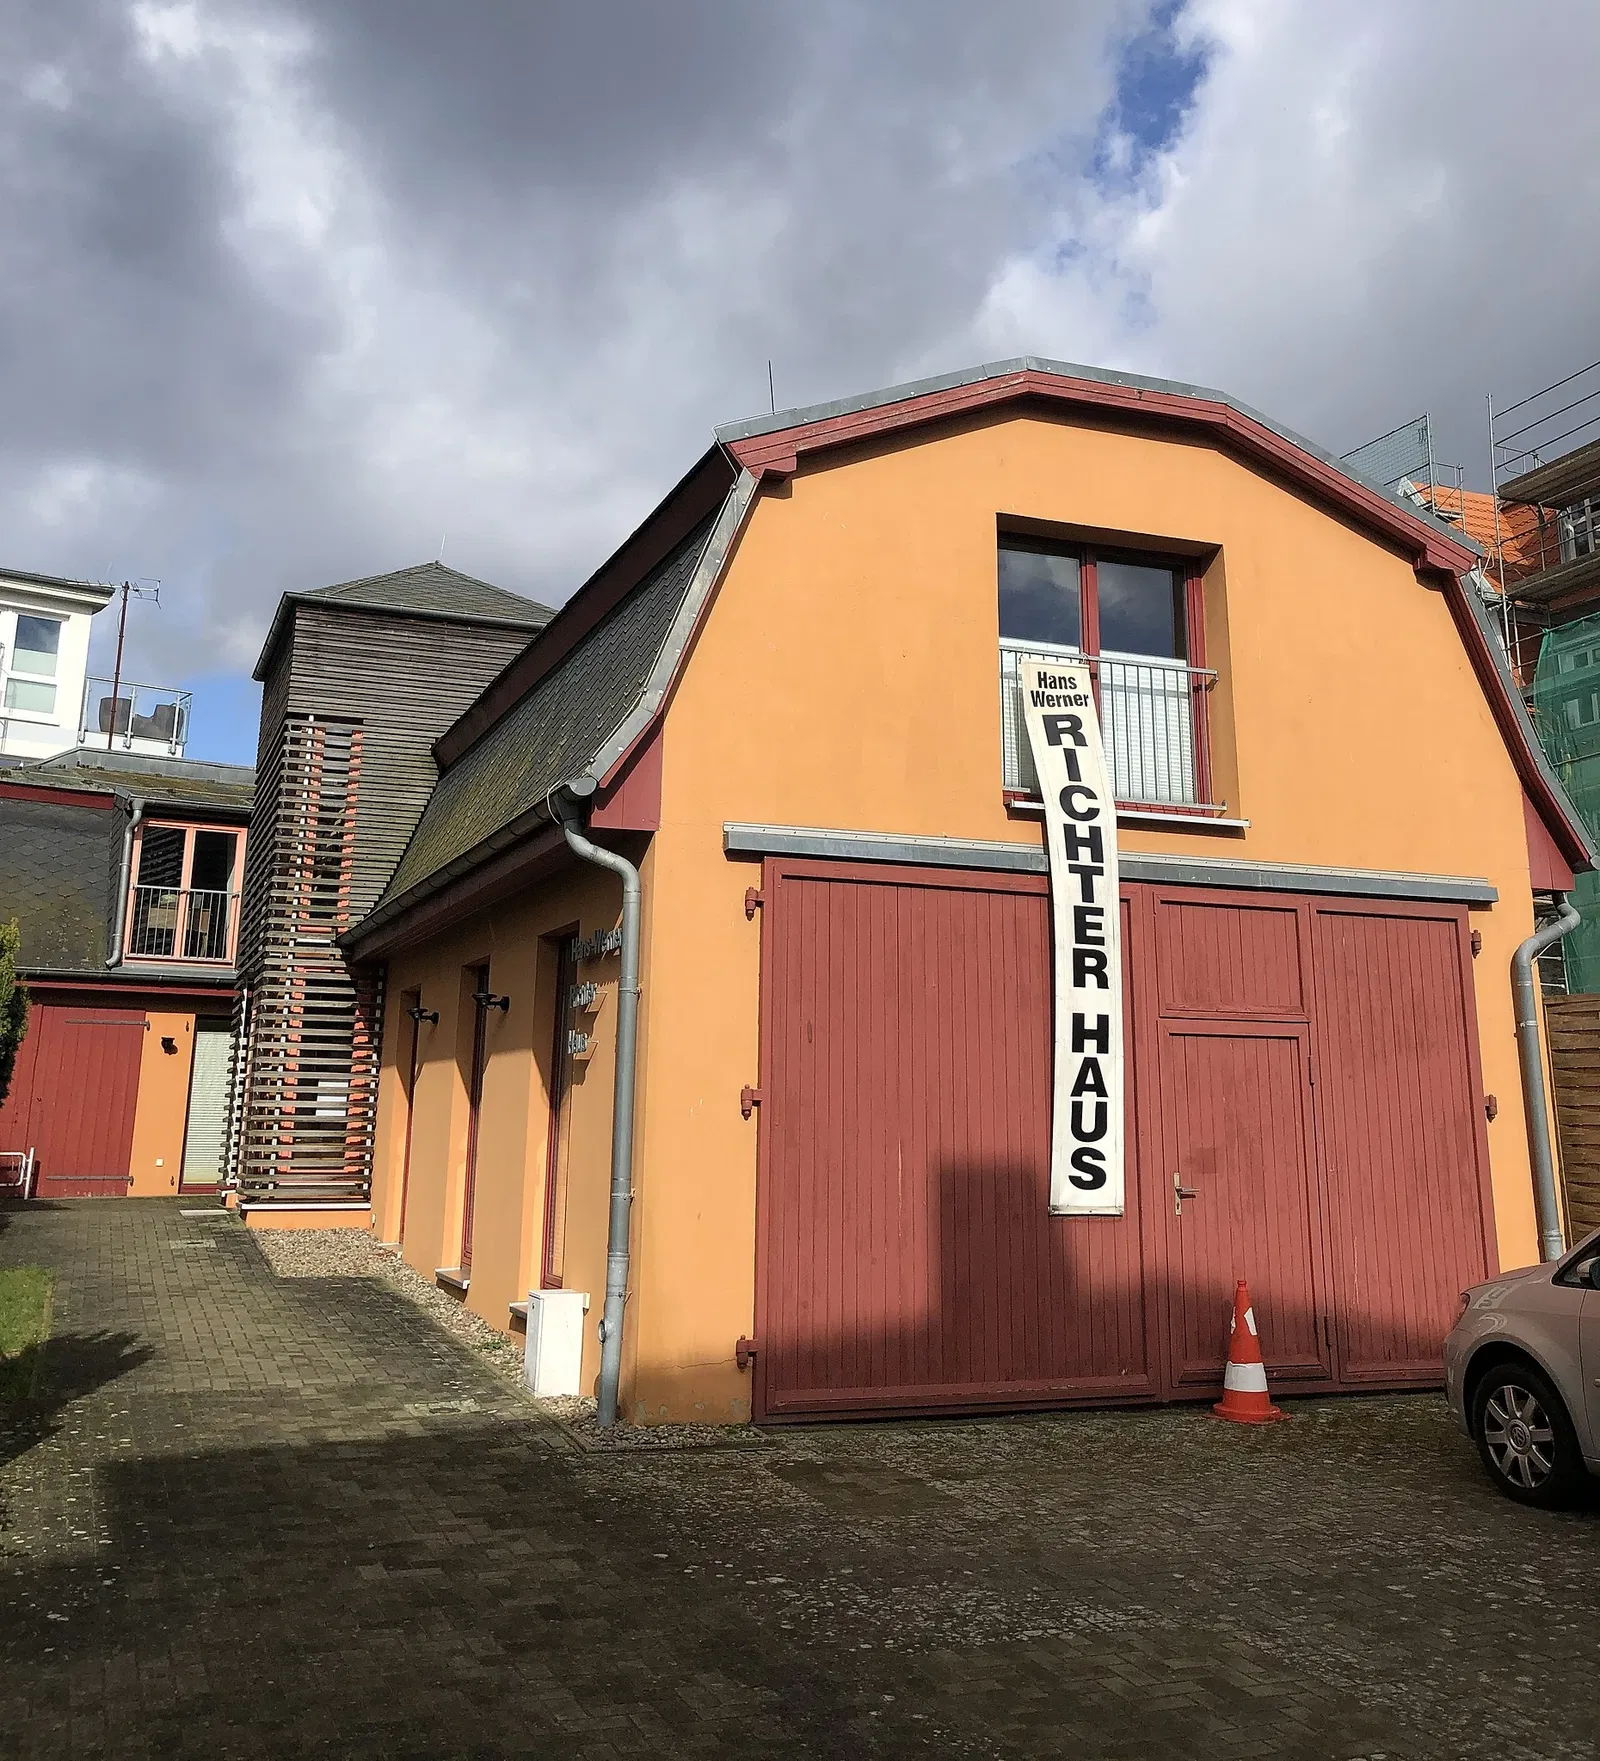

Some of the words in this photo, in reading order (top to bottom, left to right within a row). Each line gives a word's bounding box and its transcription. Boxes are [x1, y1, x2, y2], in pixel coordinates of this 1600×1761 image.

[1030, 690, 1090, 709] Werner
[1037, 671, 1078, 690] Hans
[1042, 714, 1110, 990] RICHTER
[1068, 1012, 1110, 1191] HAUS
